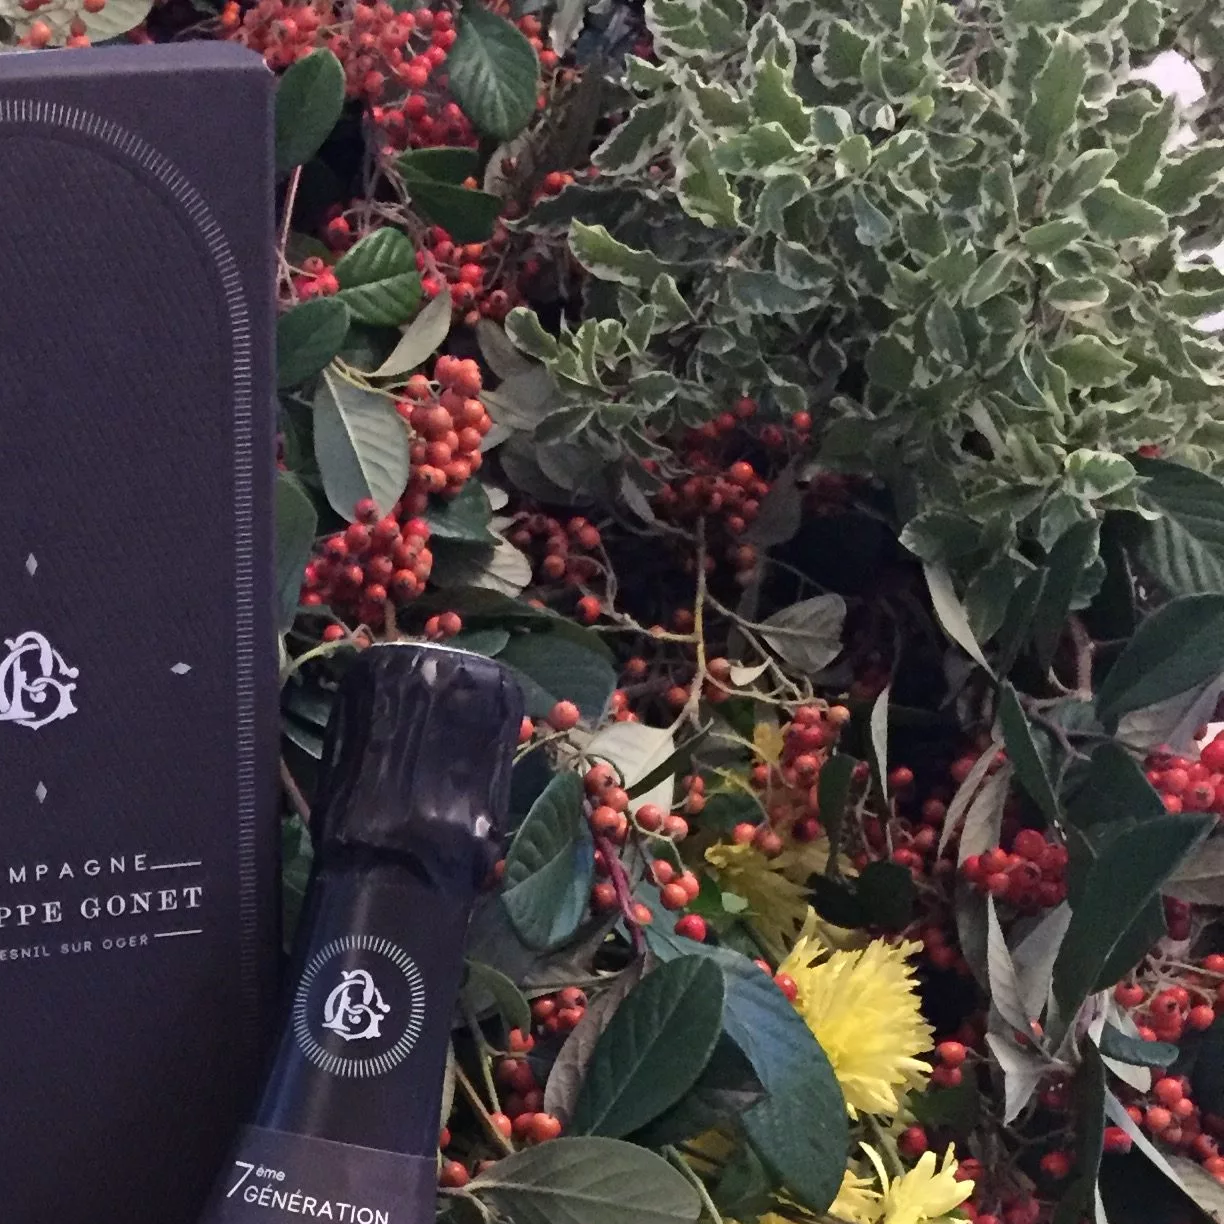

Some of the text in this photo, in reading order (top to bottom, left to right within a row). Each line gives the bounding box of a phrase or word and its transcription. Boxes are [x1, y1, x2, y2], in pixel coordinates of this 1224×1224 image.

[80, 886, 203, 920] GONET
[61, 941, 93, 955] SUR
[102, 934, 149, 950] OGER
